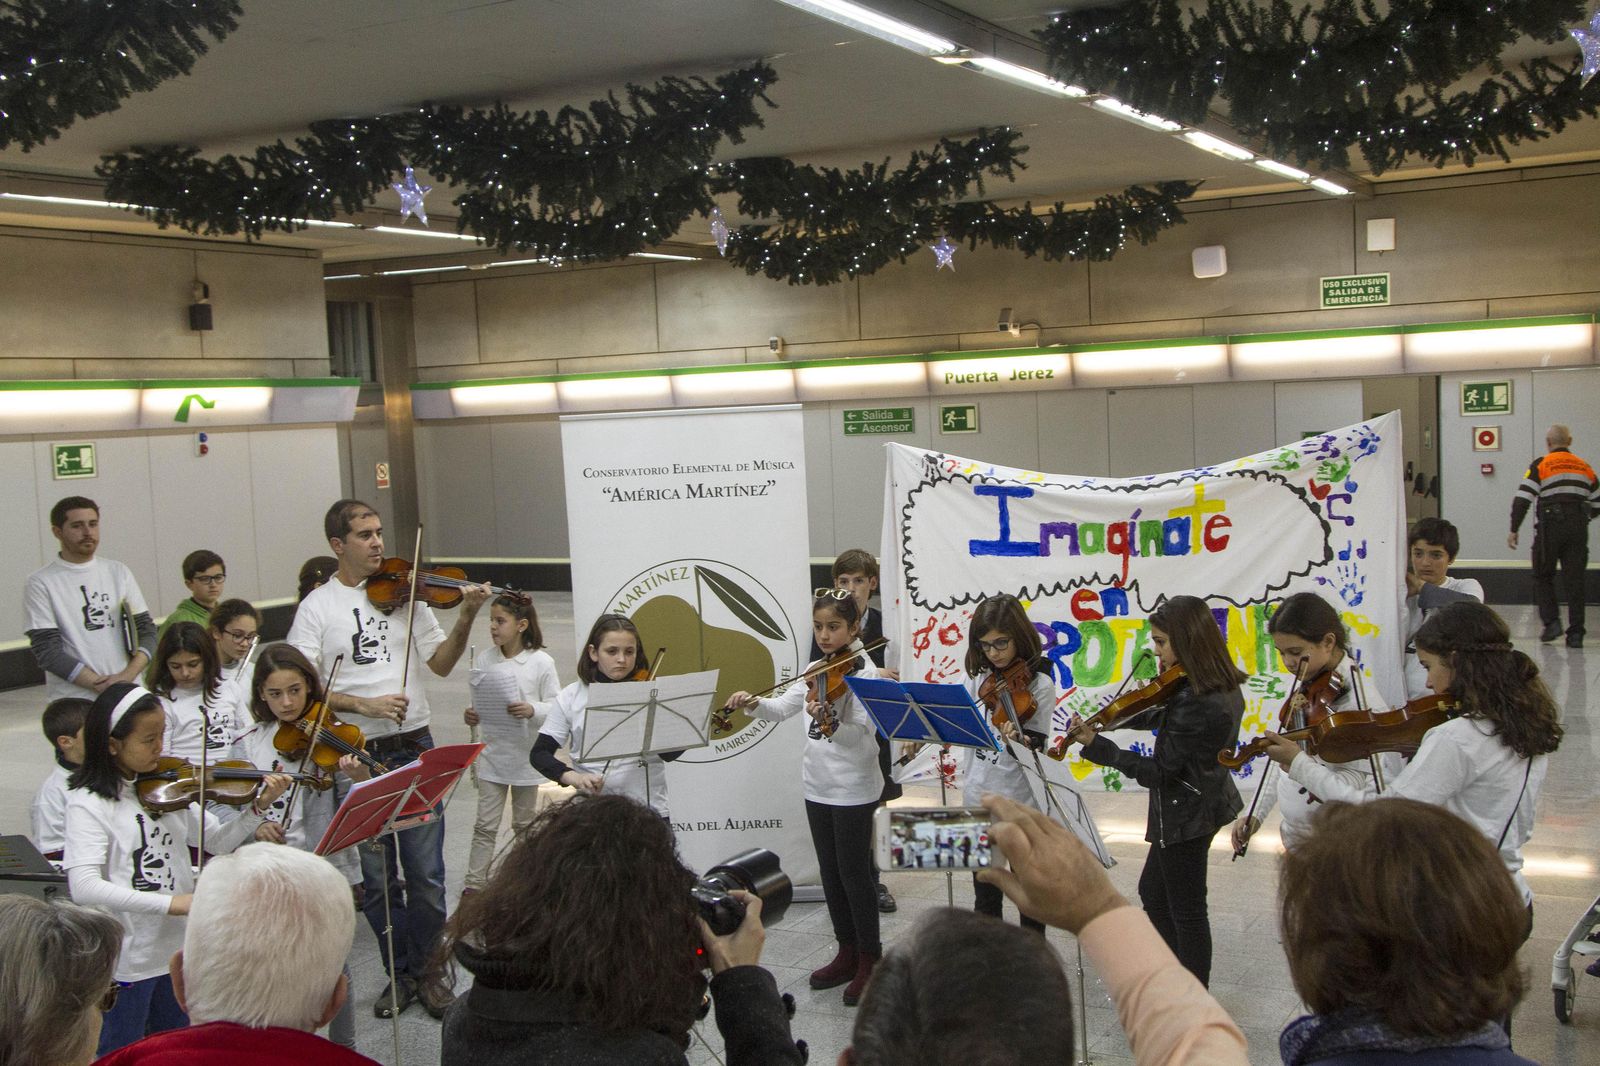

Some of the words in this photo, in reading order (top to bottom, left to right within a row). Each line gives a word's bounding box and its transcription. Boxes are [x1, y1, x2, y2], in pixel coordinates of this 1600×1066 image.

[1323, 281, 1340, 289] USO
[1342, 277, 1387, 288] EXCLUSIVO
[1328, 287, 1365, 297] SALIDA
[1367, 286, 1381, 294] DE
[1325, 294, 1385, 305] EMERGENCIA
[945, 371, 999, 385] Puerta
[1009, 368, 1054, 381] Jerez
[862, 410, 894, 420] Salida
[862, 423, 910, 433] Ascensor
[969, 483, 1232, 588] Imagínate
[613, 566, 690, 616] MARTÍNEZ
[1071, 587, 1129, 621] en
[714, 727, 760, 754] MAIRENA
[697, 821, 720, 831] DEL
[724, 817, 783, 832] ALJARAFE
